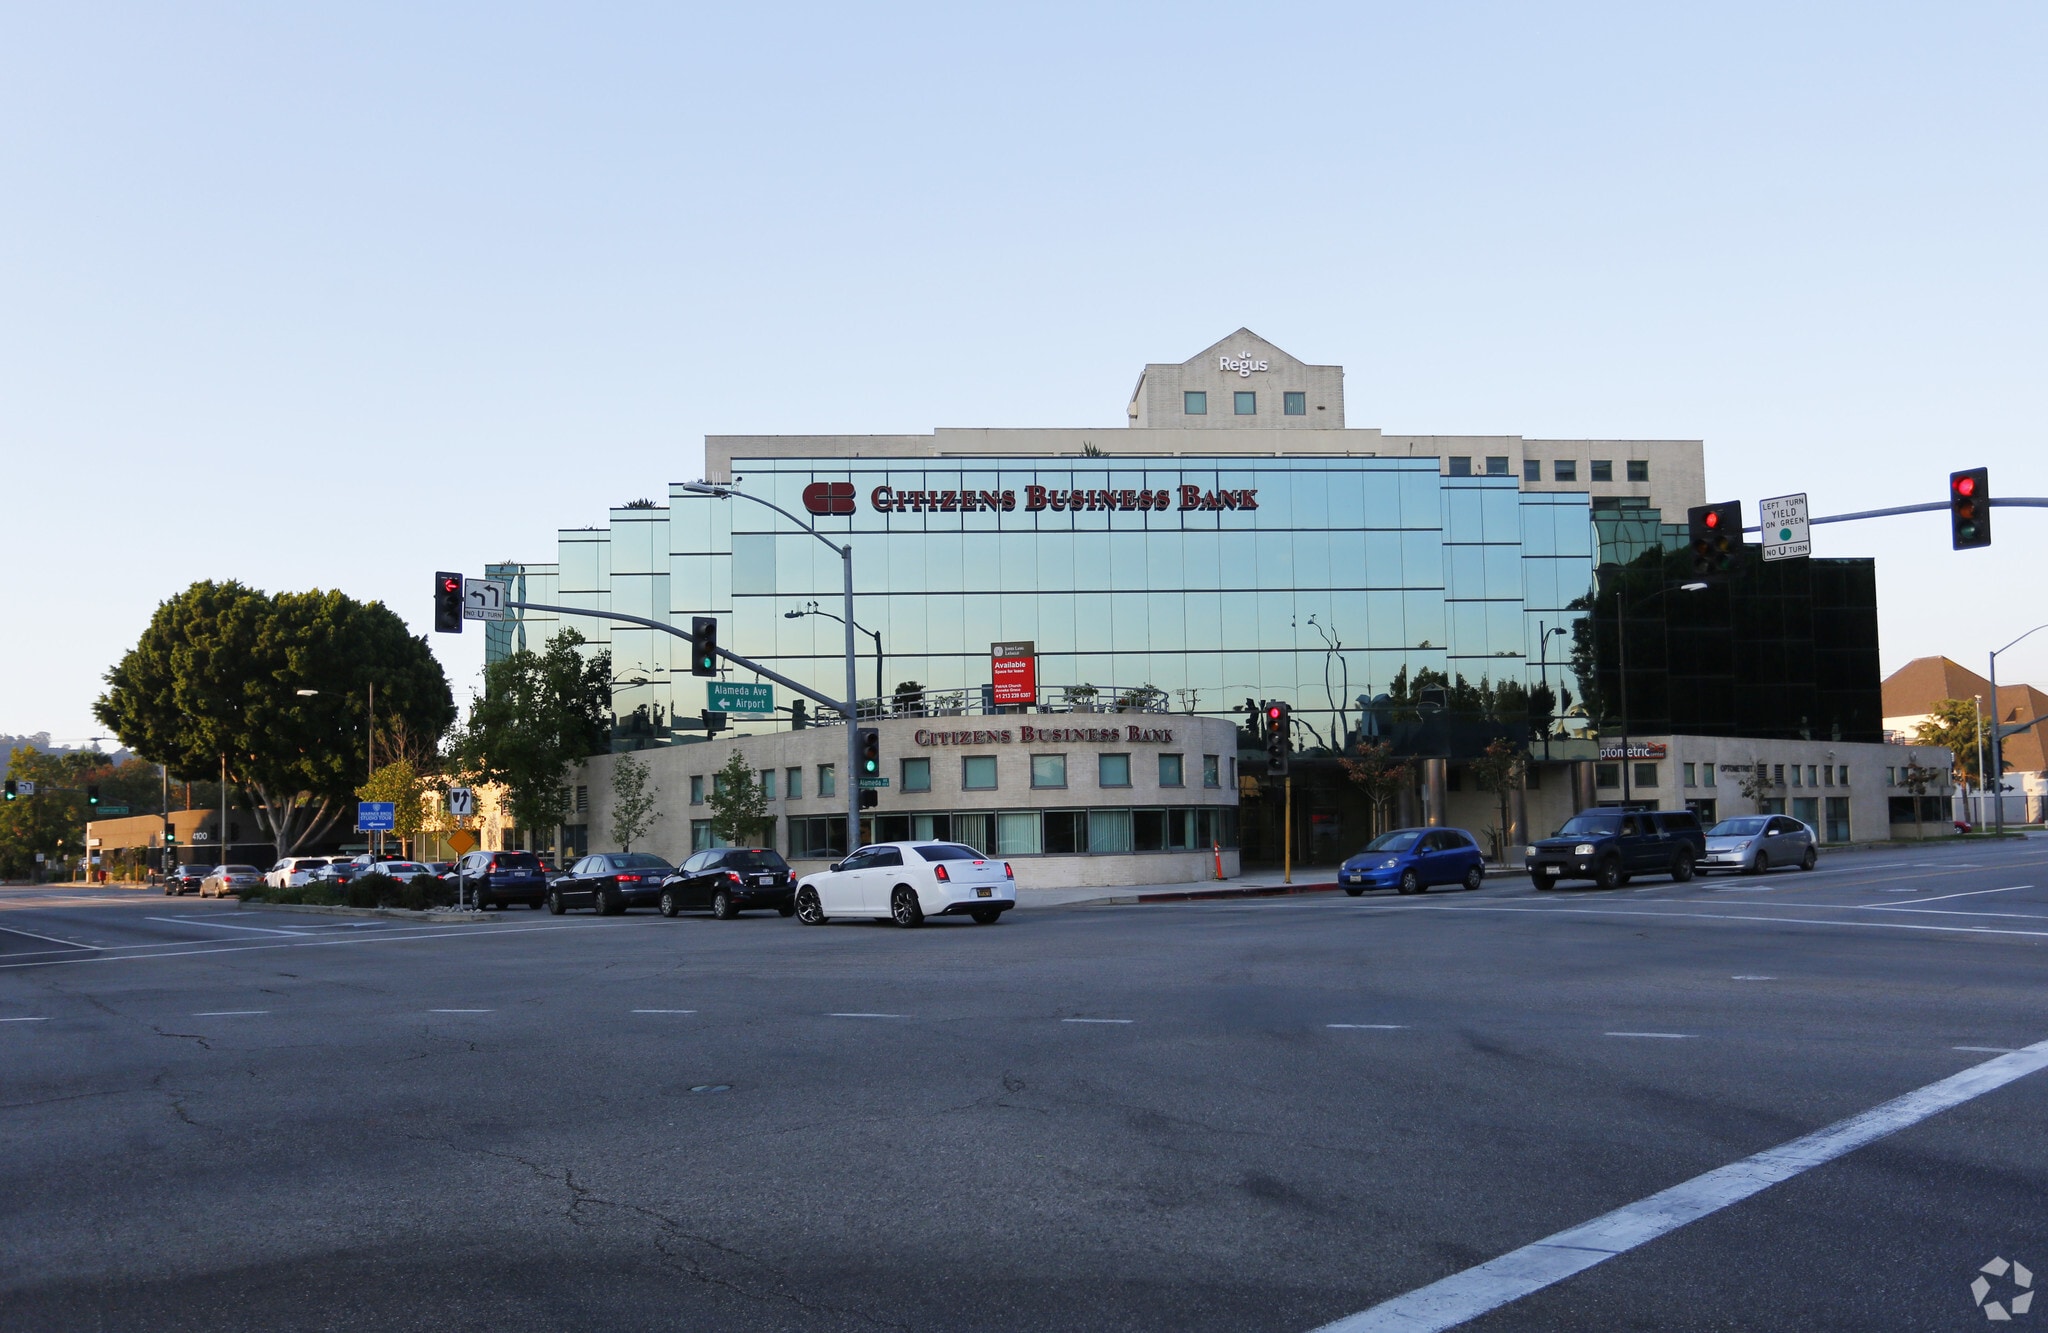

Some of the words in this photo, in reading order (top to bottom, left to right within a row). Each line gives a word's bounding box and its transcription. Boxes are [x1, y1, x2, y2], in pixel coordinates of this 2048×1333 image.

[1219, 356, 1269, 378] Regus
[1762, 502, 1779, 510] LEFT
[1785, 498, 1804, 506] TURN
[1772, 508, 1796, 519] YIELD
[1780, 517, 1804, 526] GREEN
[1779, 546, 1786, 556] U
[714, 684, 750, 696] Alameda
[752, 686, 768, 697] Ave
[735, 698, 765, 710] Airport
[192, 832, 208, 840] 4100
